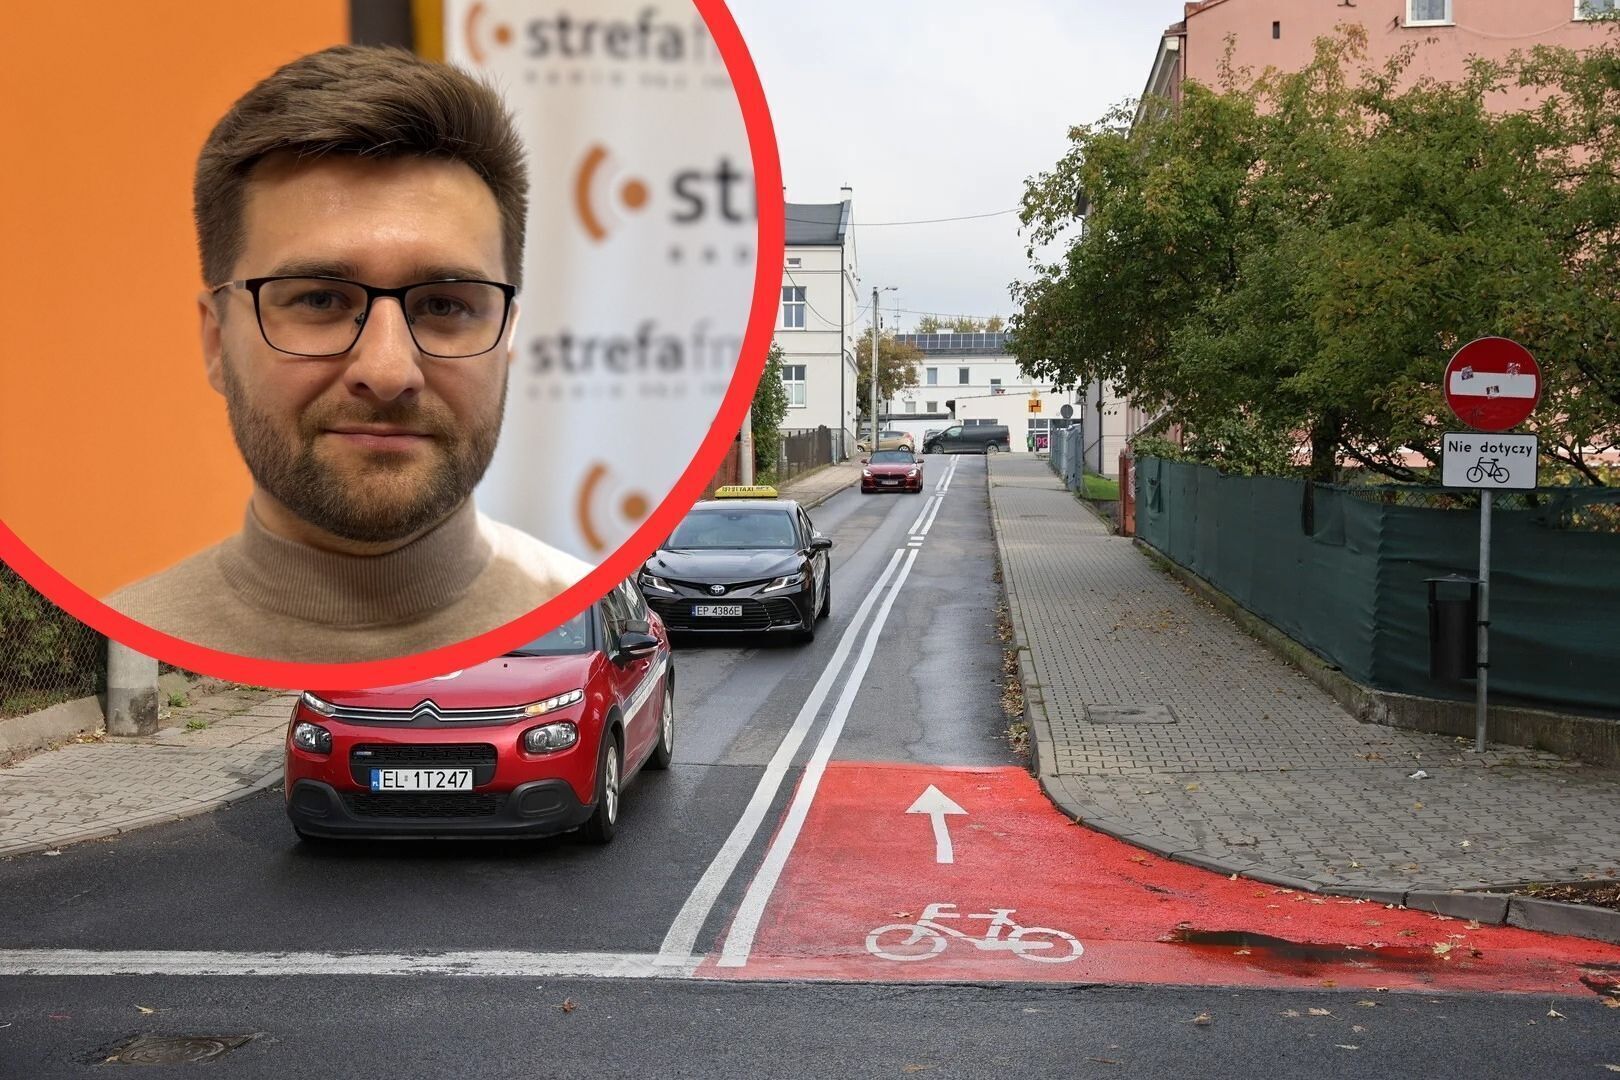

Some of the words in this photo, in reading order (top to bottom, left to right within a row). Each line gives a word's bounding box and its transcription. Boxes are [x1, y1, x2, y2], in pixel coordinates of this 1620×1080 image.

[526, 8, 686, 60] strefa
[671, 159, 758, 225] st
[530, 319, 685, 374] strefa
[1448, 441, 1472, 453] Nie
[1479, 442, 1533, 457] dotyczy
[697, 606, 709, 616] EP
[712, 606, 740, 616] 4386E
[383, 771, 405, 788] EL
[414, 771, 469, 788] 1T247
